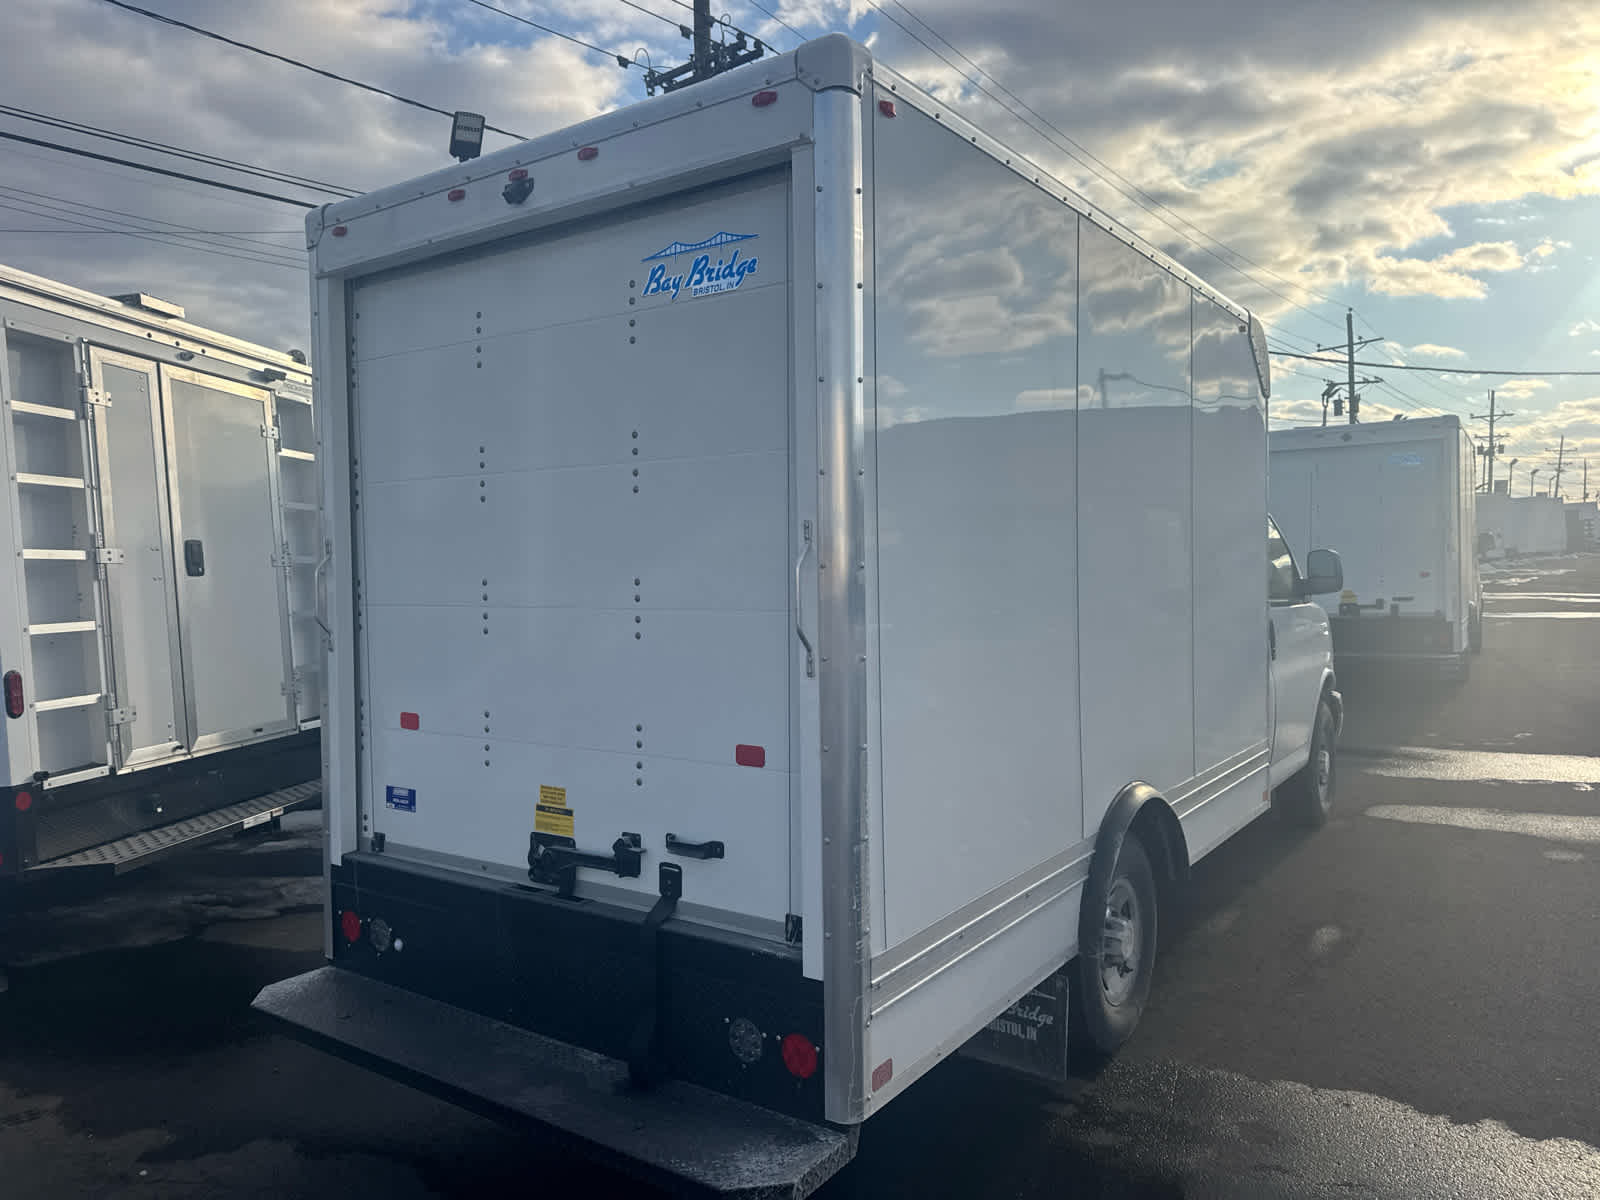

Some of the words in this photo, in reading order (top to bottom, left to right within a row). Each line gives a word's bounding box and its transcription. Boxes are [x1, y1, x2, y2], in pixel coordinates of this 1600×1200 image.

[643, 263, 684, 300] Bay
[685, 249, 758, 288] Bridge
[726, 280, 735, 290] IN
